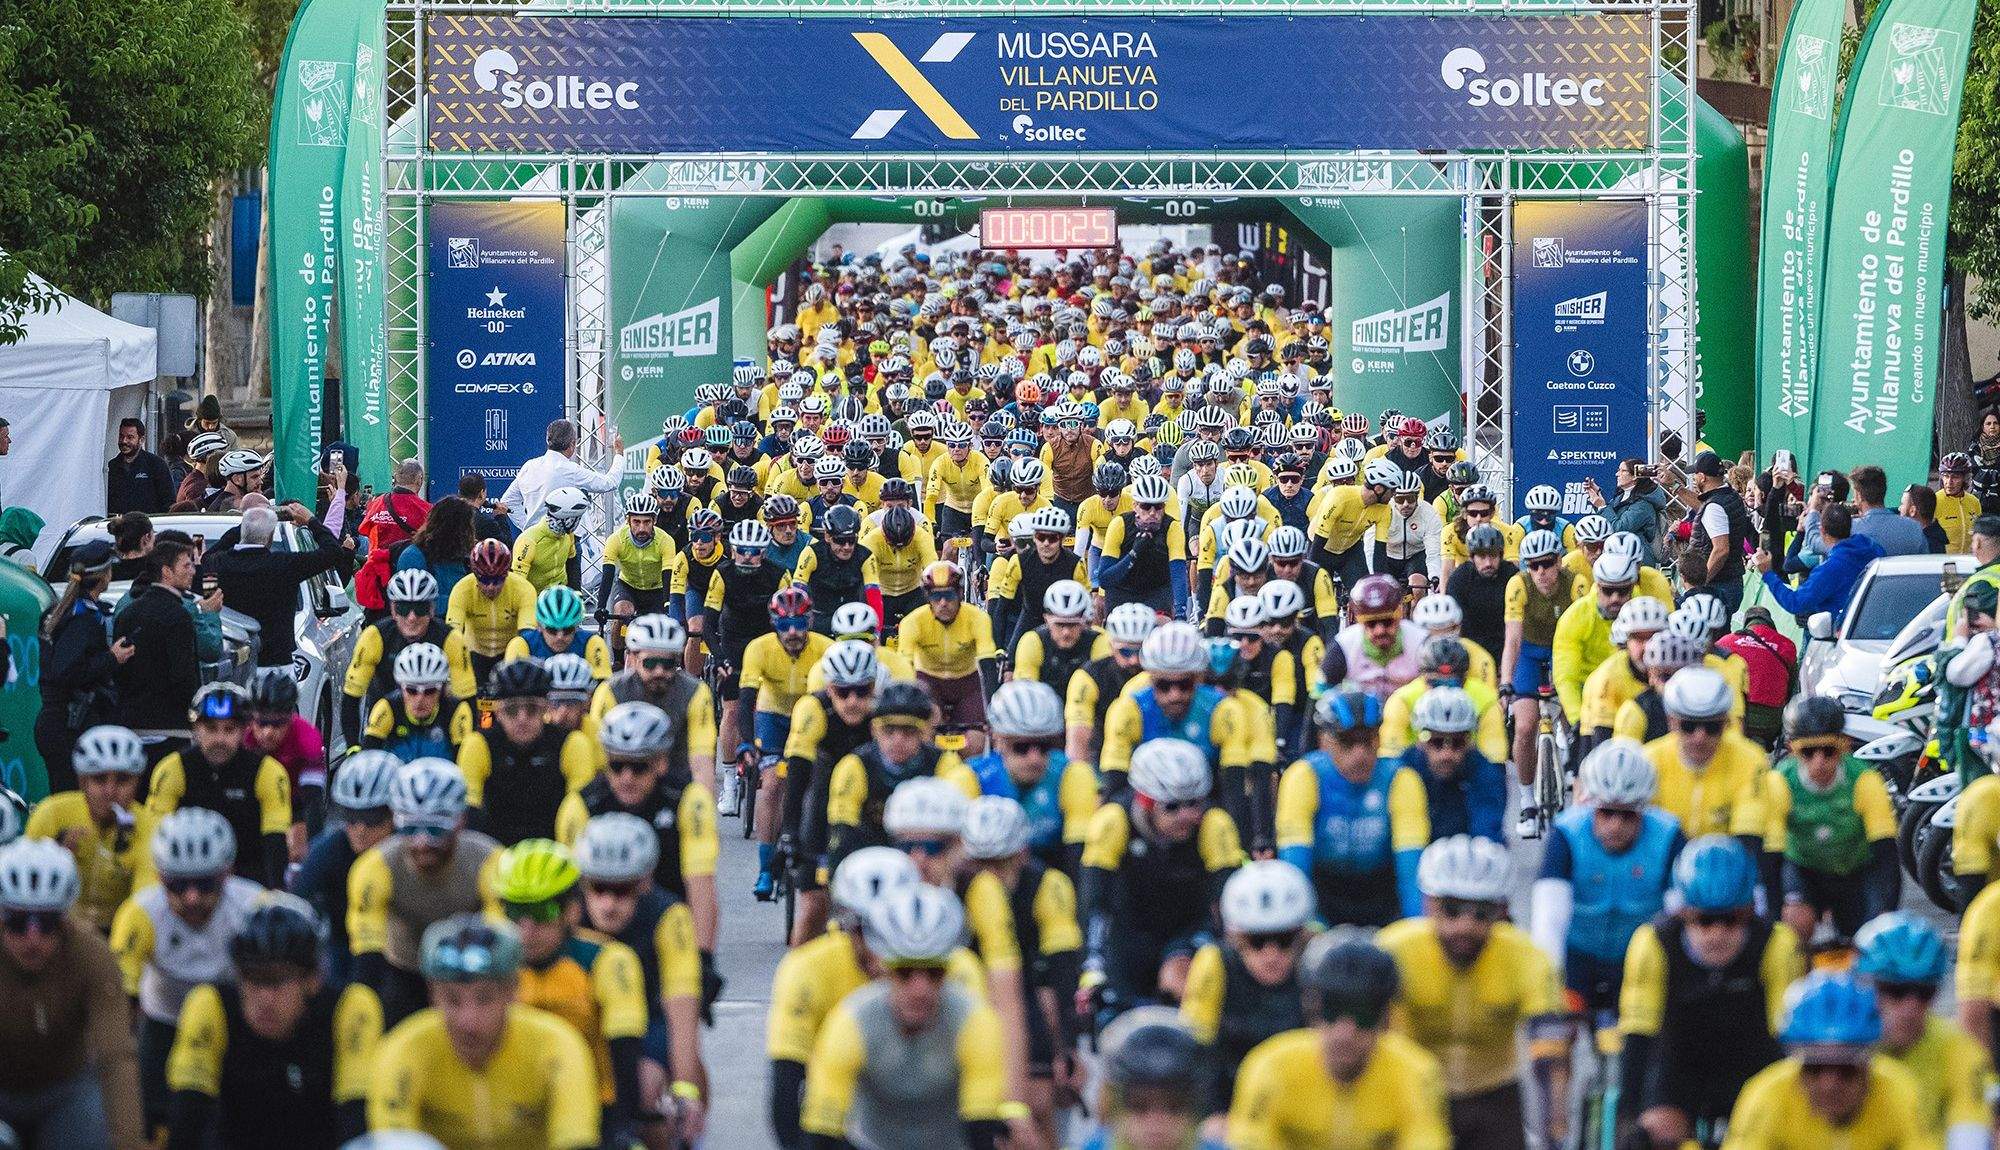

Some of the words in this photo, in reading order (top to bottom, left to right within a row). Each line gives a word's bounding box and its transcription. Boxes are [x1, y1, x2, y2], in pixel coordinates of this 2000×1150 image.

[998, 32, 1158, 58] MUSSARA
[1000, 66, 1158, 86] VILLANUEVA
[1467, 72, 1605, 107] soltec
[500, 76, 640, 110] soltec
[1000, 98, 1030, 111] DEL
[1036, 90, 1158, 111] PARDILLO
[1024, 125, 1087, 141] soltec
[914, 200, 944, 217] 0.0
[1165, 200, 1196, 217] 0.0
[1795, 152, 1809, 242] Pardillo
[1886, 149, 1914, 246] Pardillo
[319, 185, 335, 284] Pardillo
[989, 213, 1108, 243] 00:00:25
[1782, 209, 1794, 241] de
[1806, 200, 1816, 266] municipio
[1860, 210, 1882, 243] de
[1917, 202, 1933, 272] municipio
[299, 252, 316, 285] de
[1884, 255, 1904, 295] del
[467, 308, 525, 318] Heineken
[1557, 298, 1602, 315] FINISHER
[1915, 276, 1927, 318] nuevo
[488, 321, 504, 333] 0.0
[624, 312, 712, 349] FINISHER
[1355, 307, 1442, 343] FINISHER
[1778, 249, 1795, 418] Ayuntamiento
[1914, 320, 1923, 340] un
[480, 353, 536, 365] ATIKA
[1793, 296, 1809, 418] Villanueva
[1843, 254, 1879, 434] Ayuntamiento
[1368, 361, 1394, 369] KERN
[1875, 304, 1902, 435] Villanueva
[1911, 345, 1923, 403] Creando
[455, 384, 521, 393] COMPEX
[1547, 381, 1585, 390] Caetano
[1588, 381, 1615, 390] Cuzco
[485, 440, 508, 450] SKIN
[1560, 451, 1617, 460] SPEKTRUM
